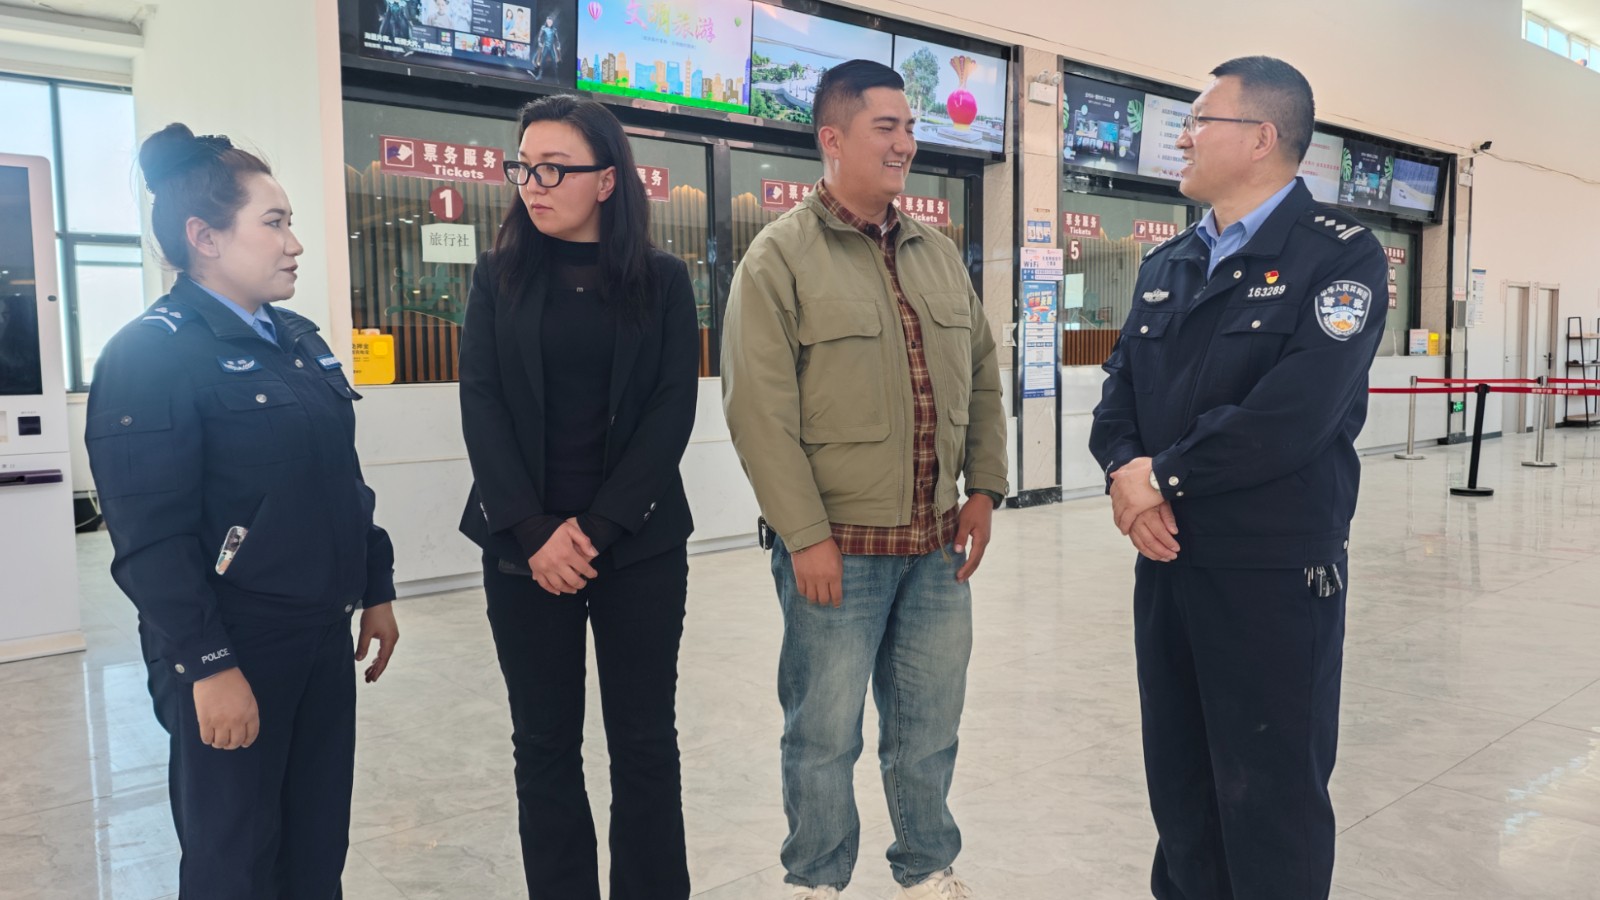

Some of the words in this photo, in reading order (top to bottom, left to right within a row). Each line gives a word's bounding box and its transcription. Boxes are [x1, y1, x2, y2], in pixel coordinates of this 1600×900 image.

[624, 0, 716, 43] 文明旅游
[423, 143, 497, 168] 票务服务
[432, 164, 485, 180] Tickets
[439, 189, 453, 218] 1
[905, 197, 945, 214] 票务服务
[910, 212, 938, 222] Tickets
[1065, 213, 1097, 228] 票务服务
[1069, 226, 1091, 236] Tickets
[1148, 222, 1175, 235] 票务服务
[429, 232, 470, 247] 旅行社
[1070, 240, 1080, 260] 5
[1389, 268, 1396, 281] 10
[1247, 284, 1286, 298] 163289
[1320, 283, 1369, 301] 中华人民共和国
[201, 648, 231, 664] POLICE
